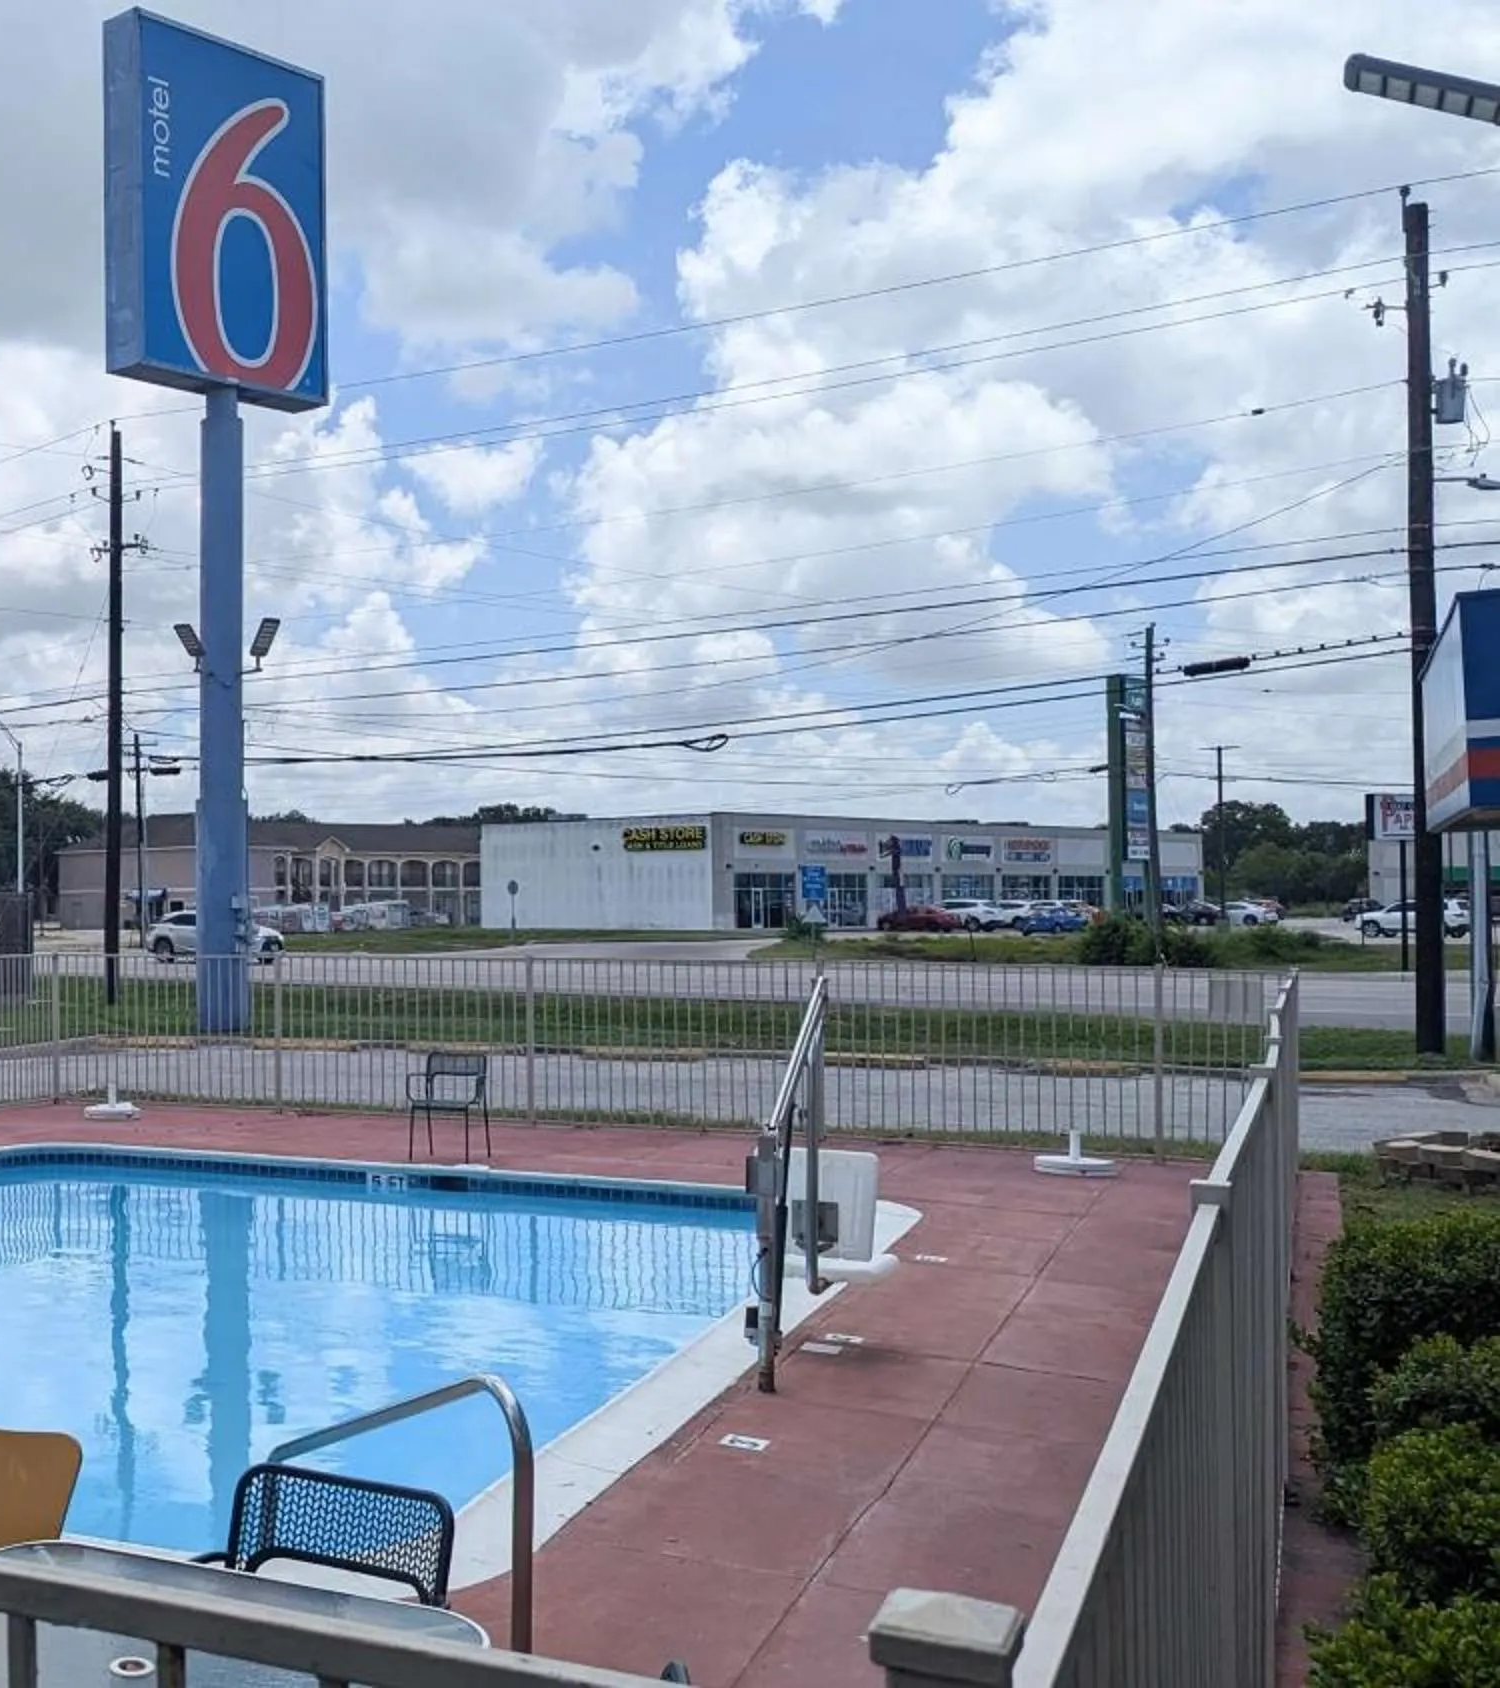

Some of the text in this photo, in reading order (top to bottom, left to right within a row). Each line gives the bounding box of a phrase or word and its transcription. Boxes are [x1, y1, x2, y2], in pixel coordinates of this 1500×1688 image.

[147, 75, 171, 178] motel
[170, 97, 320, 391] 6
[622, 826, 703, 842] CASH STORE
